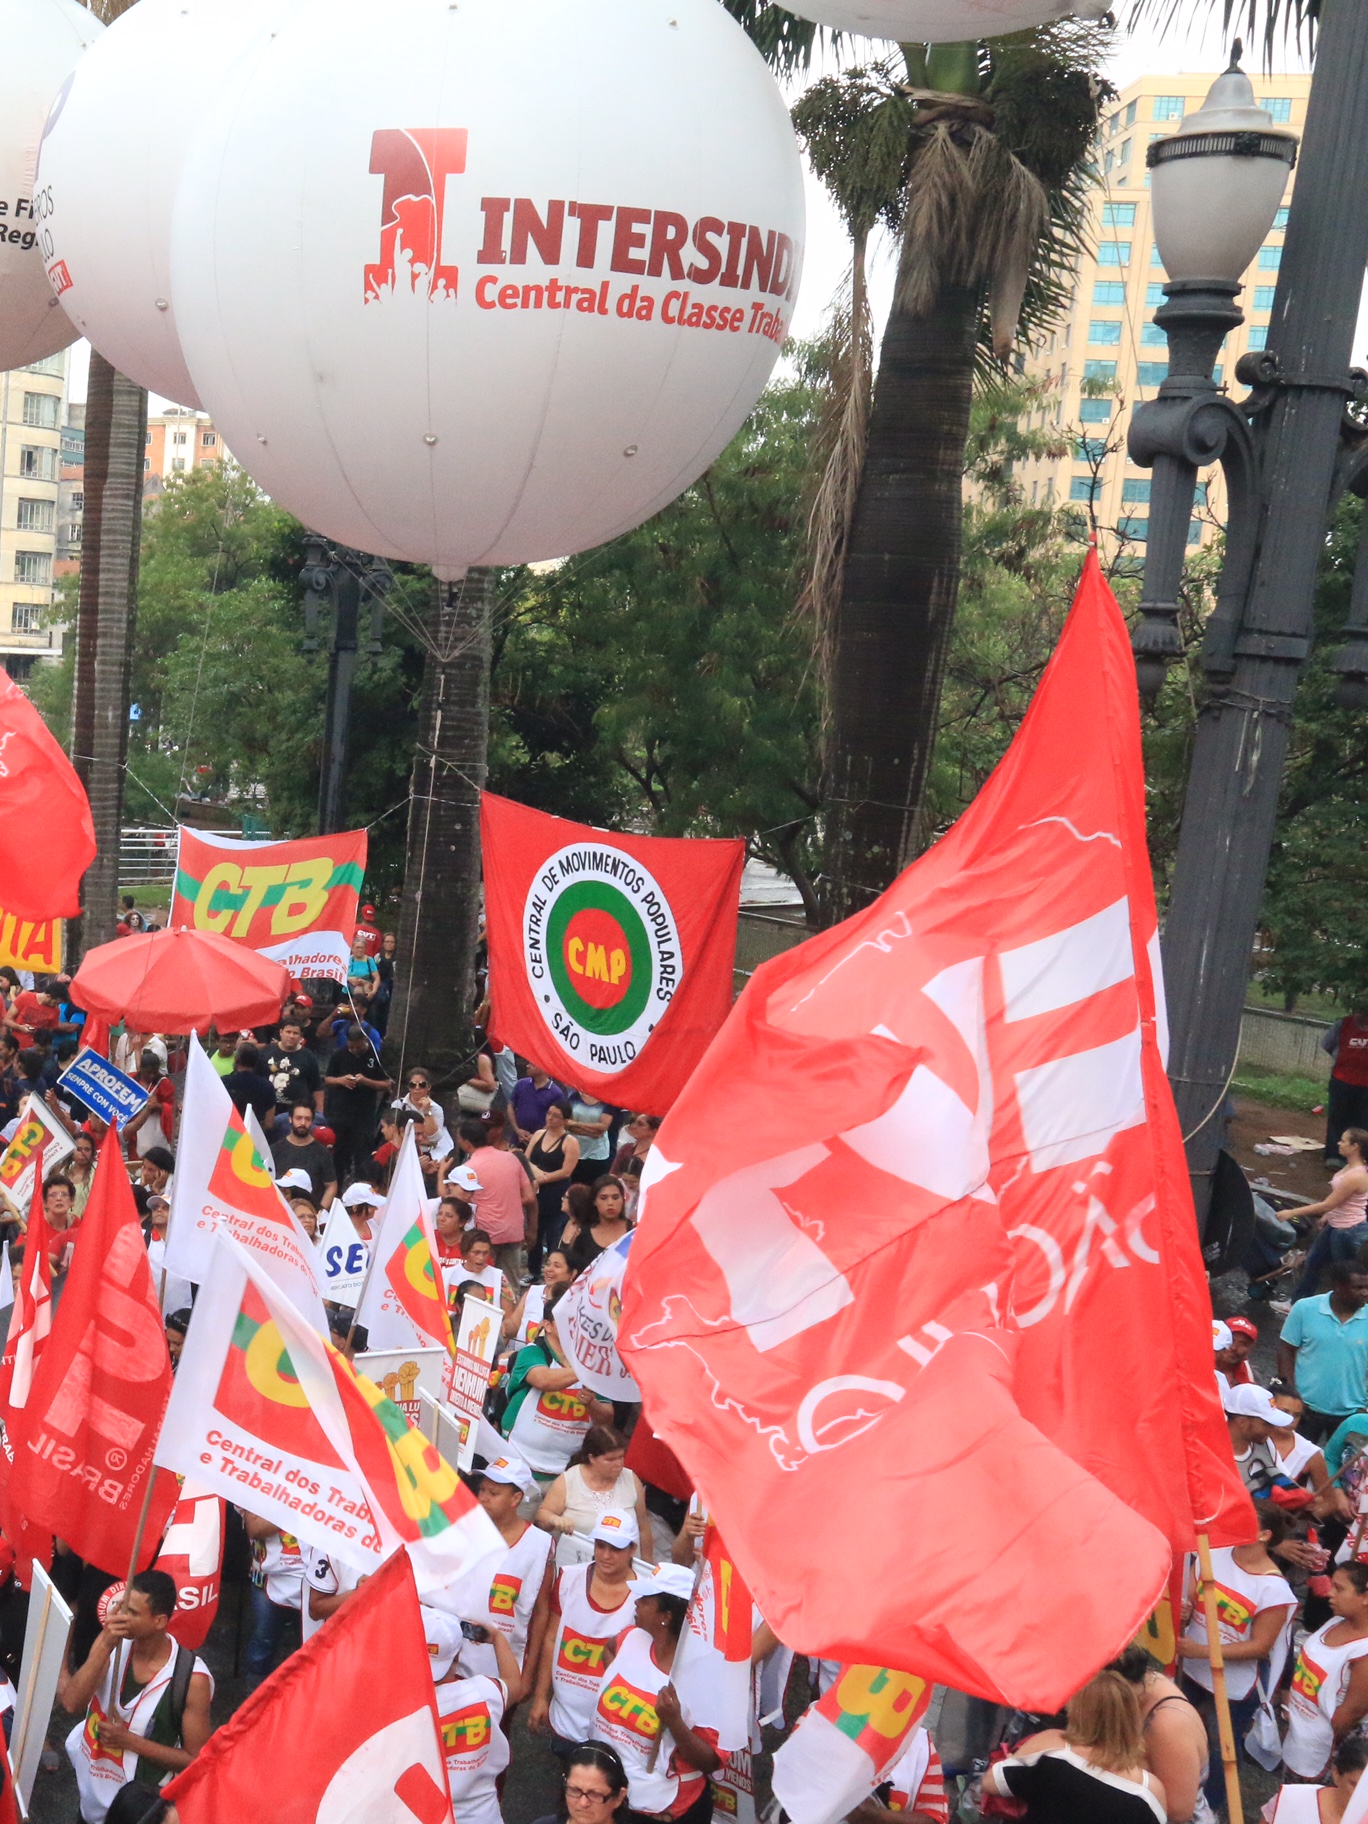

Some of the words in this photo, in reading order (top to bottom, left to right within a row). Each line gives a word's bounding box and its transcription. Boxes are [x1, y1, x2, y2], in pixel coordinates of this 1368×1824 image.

[15, 198, 34, 219] Fi
[475, 275, 610, 316] Central
[615, 284, 654, 322] da
[661, 291, 744, 336] Classe
[193, 857, 334, 938] CTB
[527, 893, 548, 980] CENTRAL
[541, 866, 560, 893] DE
[558, 850, 645, 895] MOVIMENTOS
[640, 891, 677, 1004] POPULARES
[300, 966, 344, 983] Brasil
[568, 936, 627, 985] CMP
[551, 1012, 581, 1051] SÃO
[590, 1040, 637, 1066] PAULO
[65, 1071, 94, 1095] SEMPRE
[92, 1092, 109, 1109] COM
[108, 1104, 129, 1124] VOCÊ
[75, 1056, 142, 1112] APROFEM
[197, 1219, 206, 1229] e
[256, 1225, 279, 1243] dos
[325, 1242, 370, 1277] SE
[542, 1389, 587, 1418] CTB
[206, 1428, 284, 1474] Central
[285, 1467, 321, 1495] dos
[200, 1451, 212, 1464] e
[218, 1455, 357, 1540] Trabalhadoras
[315, 1559, 330, 1579] 3
[564, 1638, 605, 1669] CT
[440, 1714, 487, 1748] TB
[602, 1685, 661, 1735] CTB
